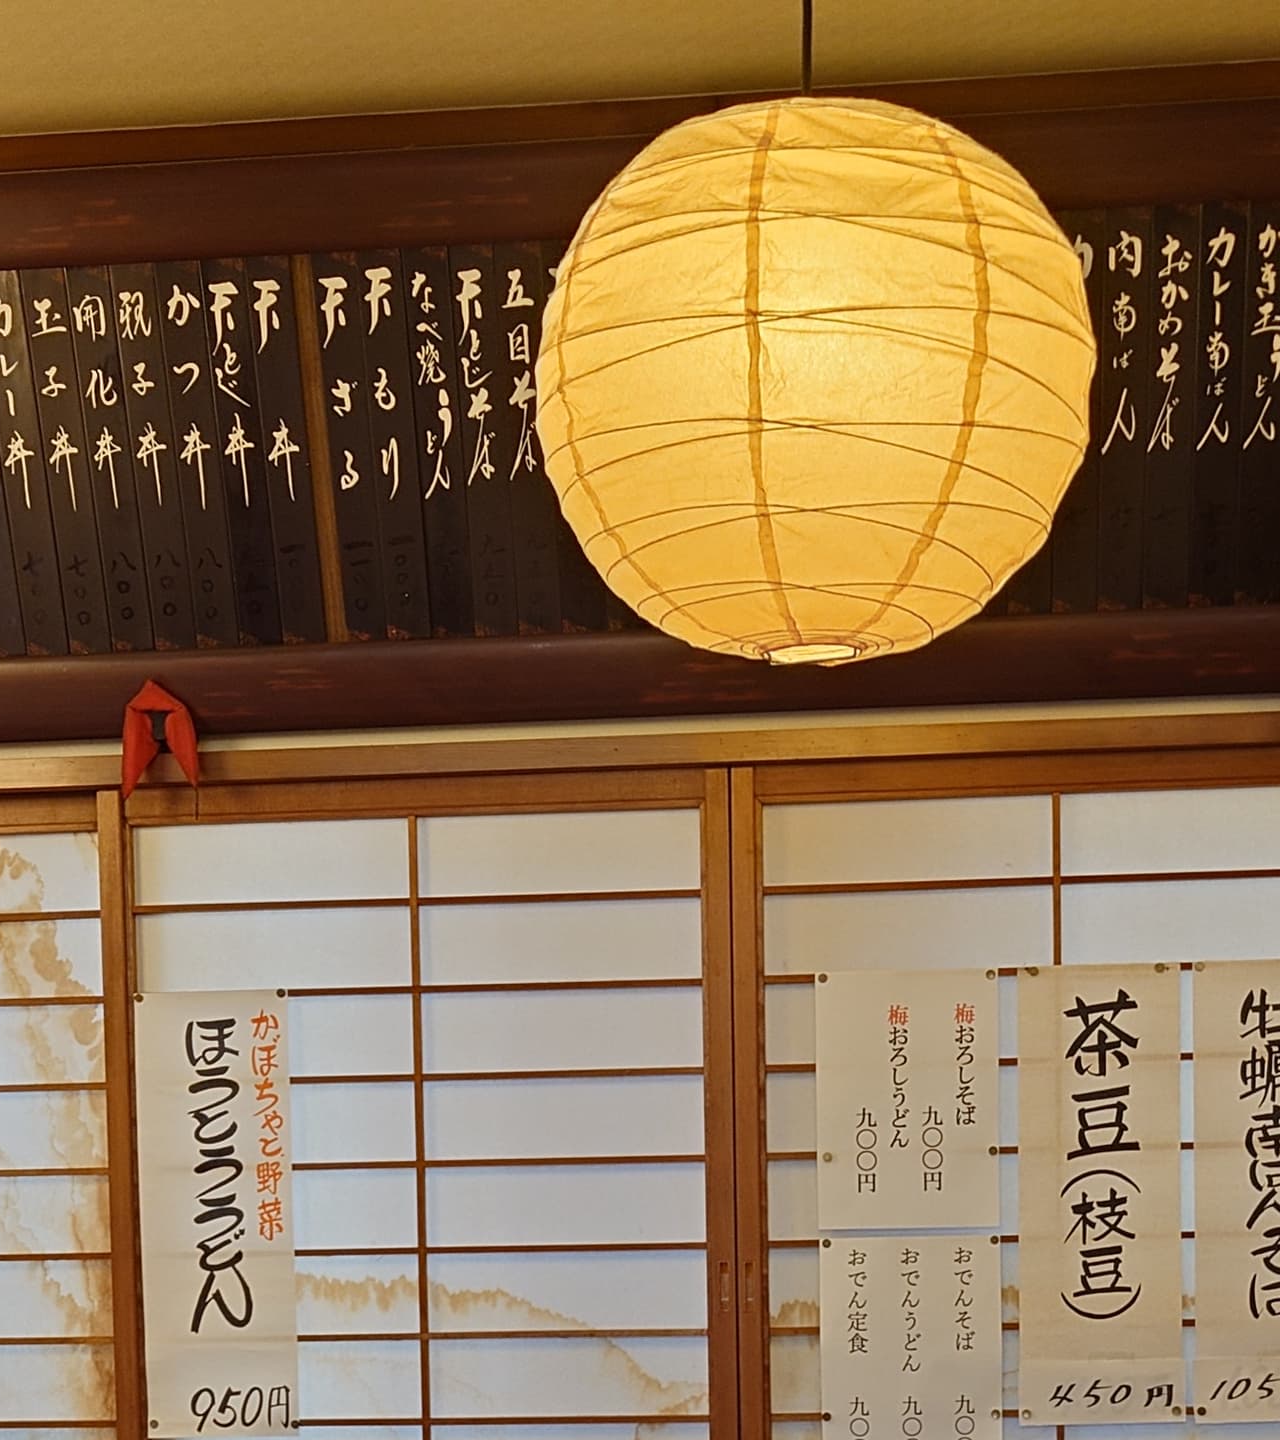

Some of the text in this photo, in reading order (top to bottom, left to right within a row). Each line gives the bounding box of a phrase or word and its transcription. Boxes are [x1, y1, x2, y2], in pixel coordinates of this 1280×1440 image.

[118, 291, 168, 508] 親子丼
[167, 284, 211, 510] かつ丼
[252, 279, 301, 503] 天丼
[363, 267, 401, 499] 天もり
[184, 1018, 254, 1334] ほうとううどん
[250, 1008, 285, 1243] かぼちゃと野菜
[855, 1004, 911, 1194] 梅おろしうどん 九〇〇円
[921, 1002, 977, 1193] 梅おろしそば 九〇〇円
[847, 1248, 869, 1355] おでん定食
[900, 1247, 922, 1374] おでんうどん
[953, 1246, 976, 1352] おでんそば
[1048, 1379, 1176, 1410] 450円
[189, 1384, 292, 1432] 950円
